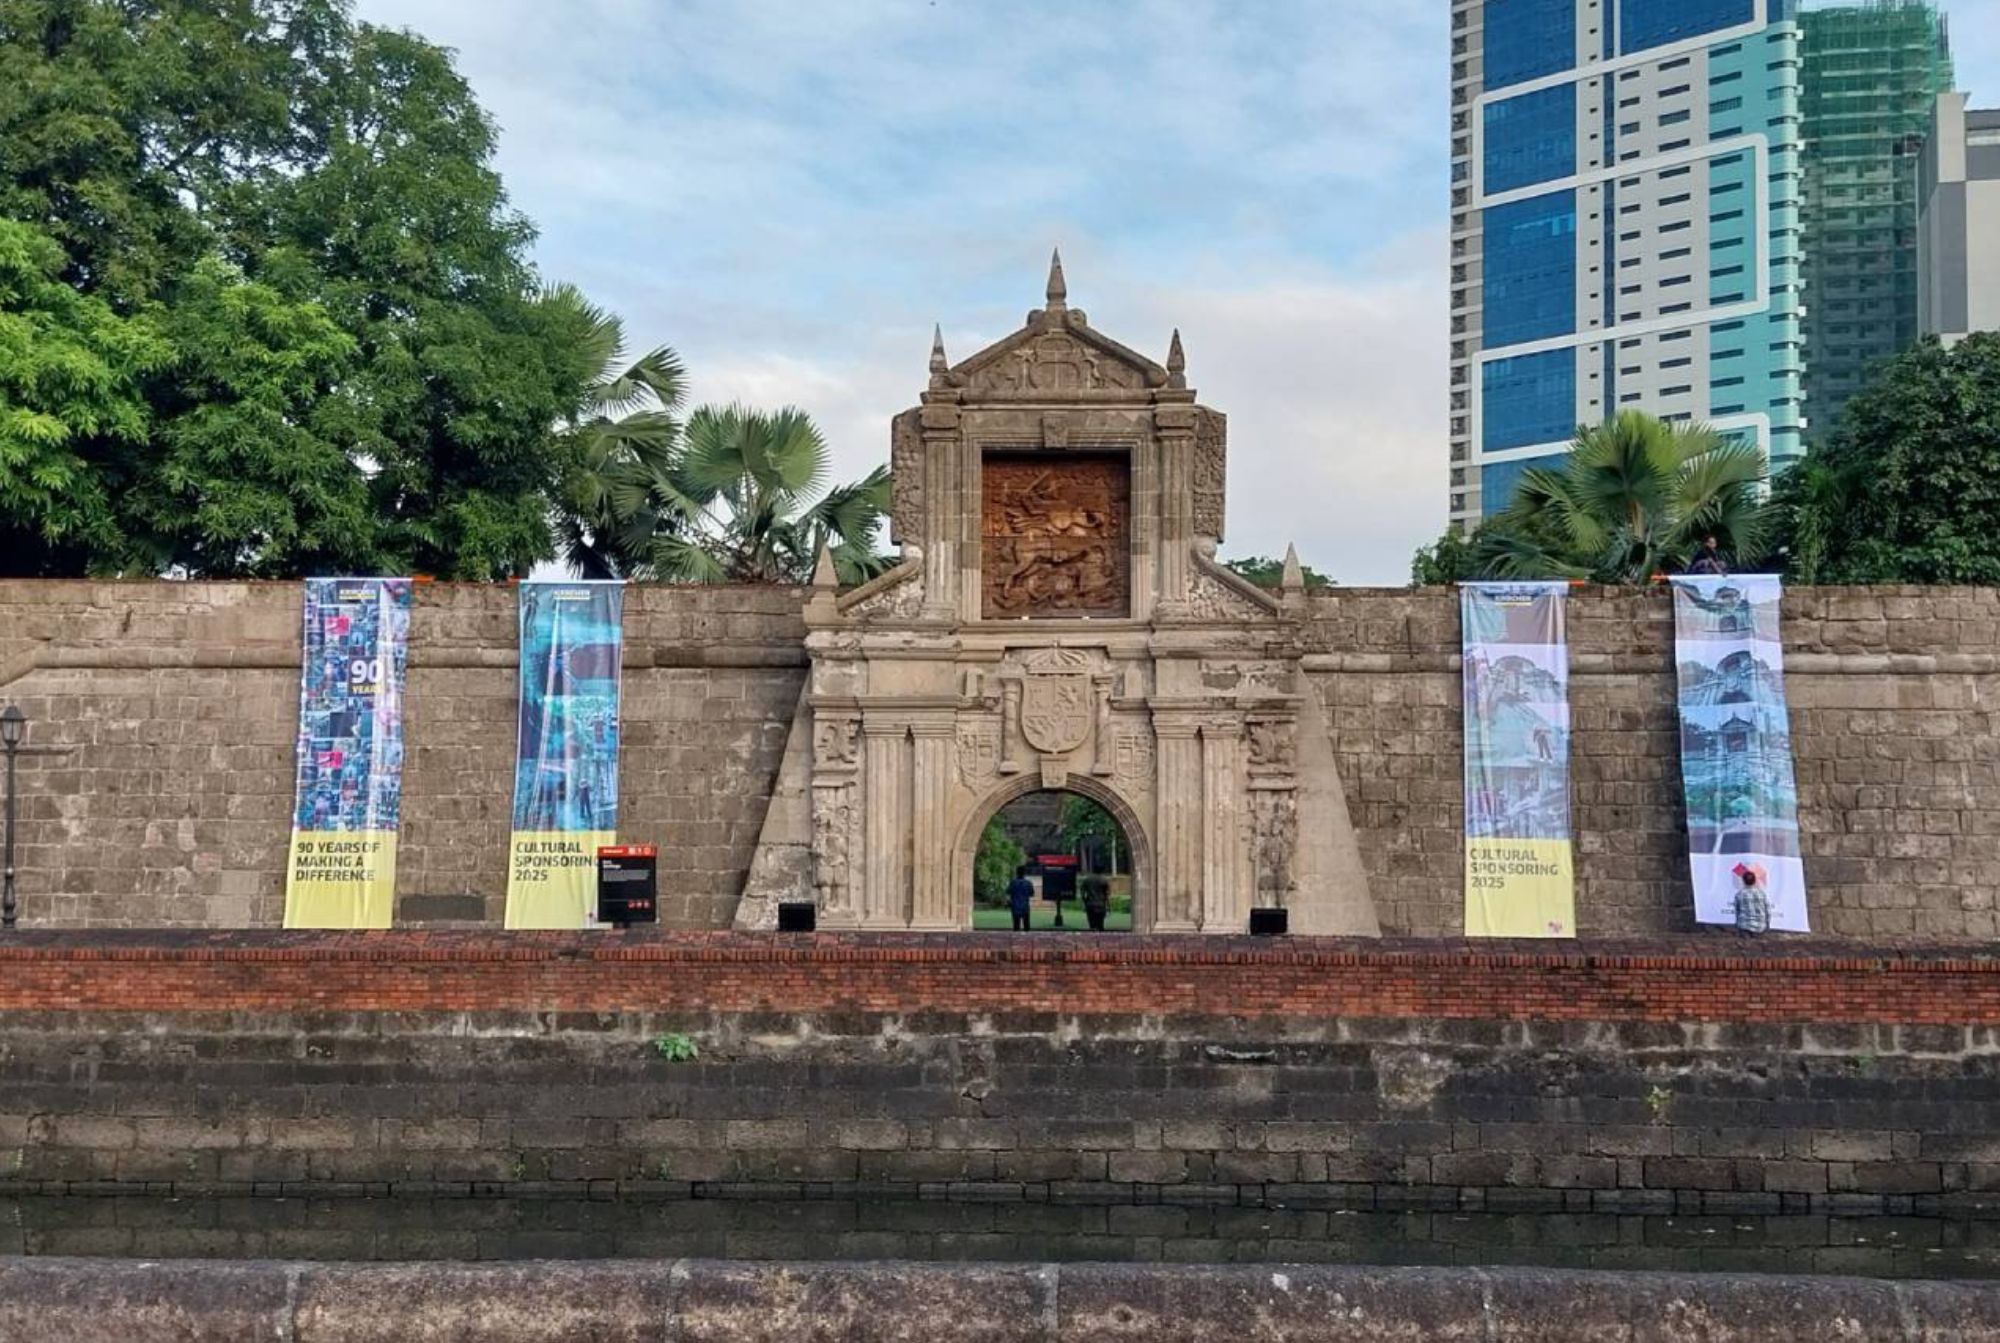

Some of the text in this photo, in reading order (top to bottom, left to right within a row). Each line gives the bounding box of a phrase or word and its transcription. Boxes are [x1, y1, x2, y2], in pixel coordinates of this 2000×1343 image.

[351, 660, 384, 684] 90
[351, 684, 384, 694] YEA
[297, 842, 314, 853] 90
[318, 842, 360, 853] YEARS
[516, 842, 583, 853] CULTURAL
[1470, 848, 1538, 861] CULTURAL
[296, 855, 364, 867] MAKING A
[1470, 862, 1559, 875] SPONSORING
[295, 869, 376, 881] DIFFERENCE
[515, 869, 548, 881] 2025
[1471, 876, 1505, 889] 2025
